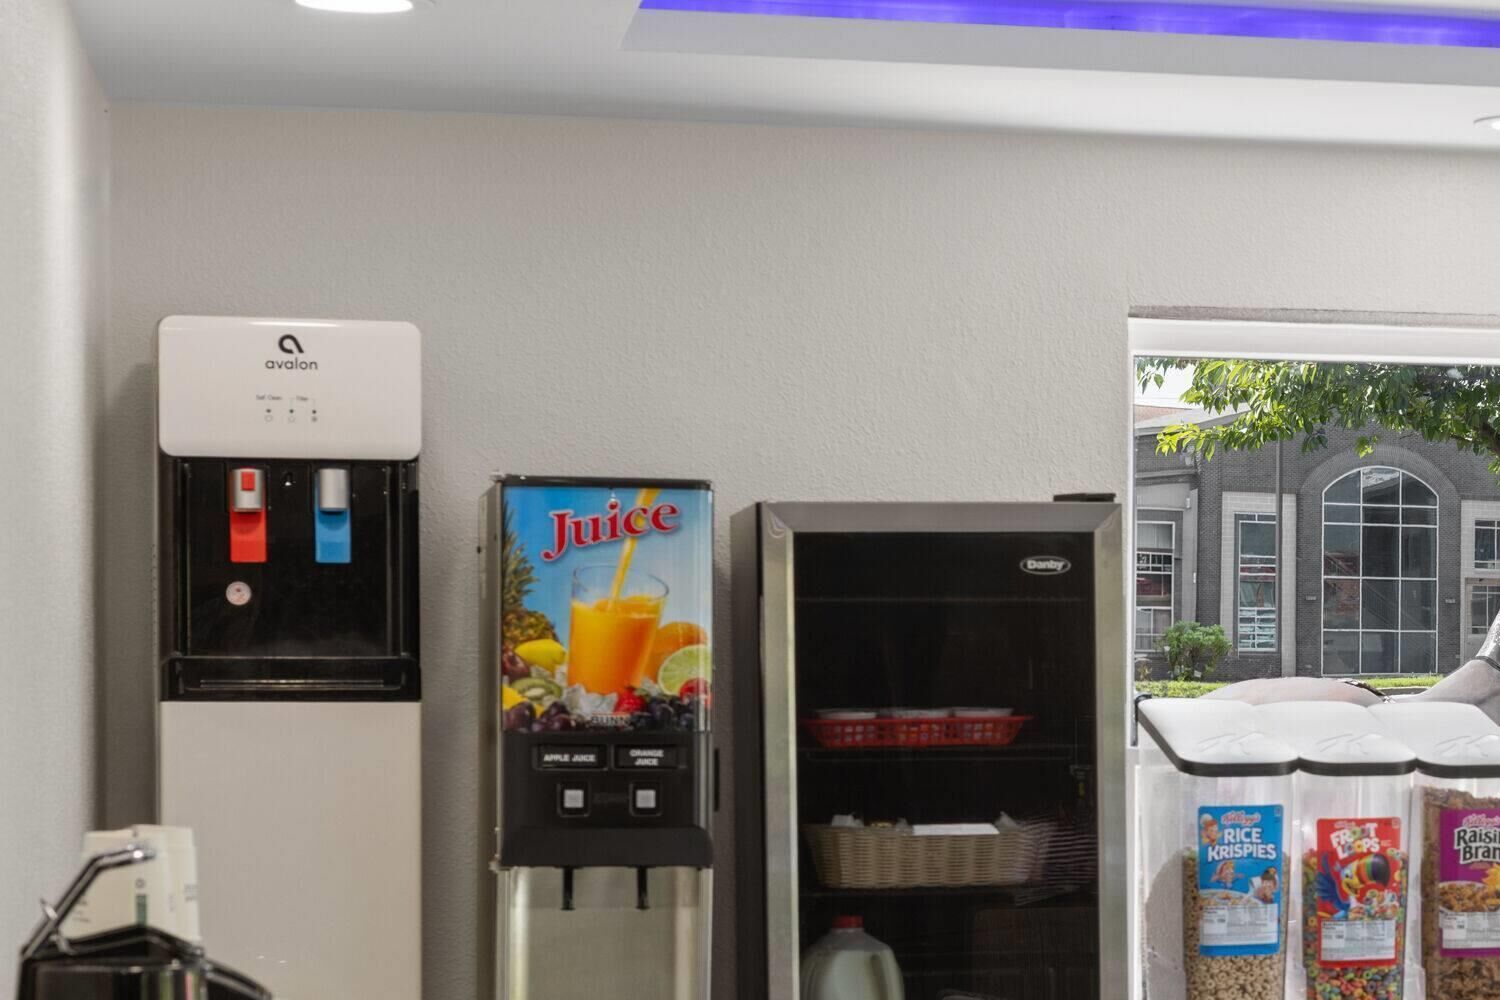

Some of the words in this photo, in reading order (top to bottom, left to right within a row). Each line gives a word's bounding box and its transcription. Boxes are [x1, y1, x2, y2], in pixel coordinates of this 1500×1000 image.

[265, 356, 318, 370] avalon
[540, 500, 680, 561] Juice
[1027, 559, 1065, 571] Danby
[543, 754, 570, 763] APPLE
[571, 754, 596, 763] JUICE
[629, 749, 664, 757] ORANGE
[634, 758, 659, 766] JUICE
[1223, 827, 1262, 844] RICE
[1330, 822, 1378, 848] FROOT
[1207, 843, 1277, 862] KRISPIES
[1336, 838, 1380, 860] LOOPS
